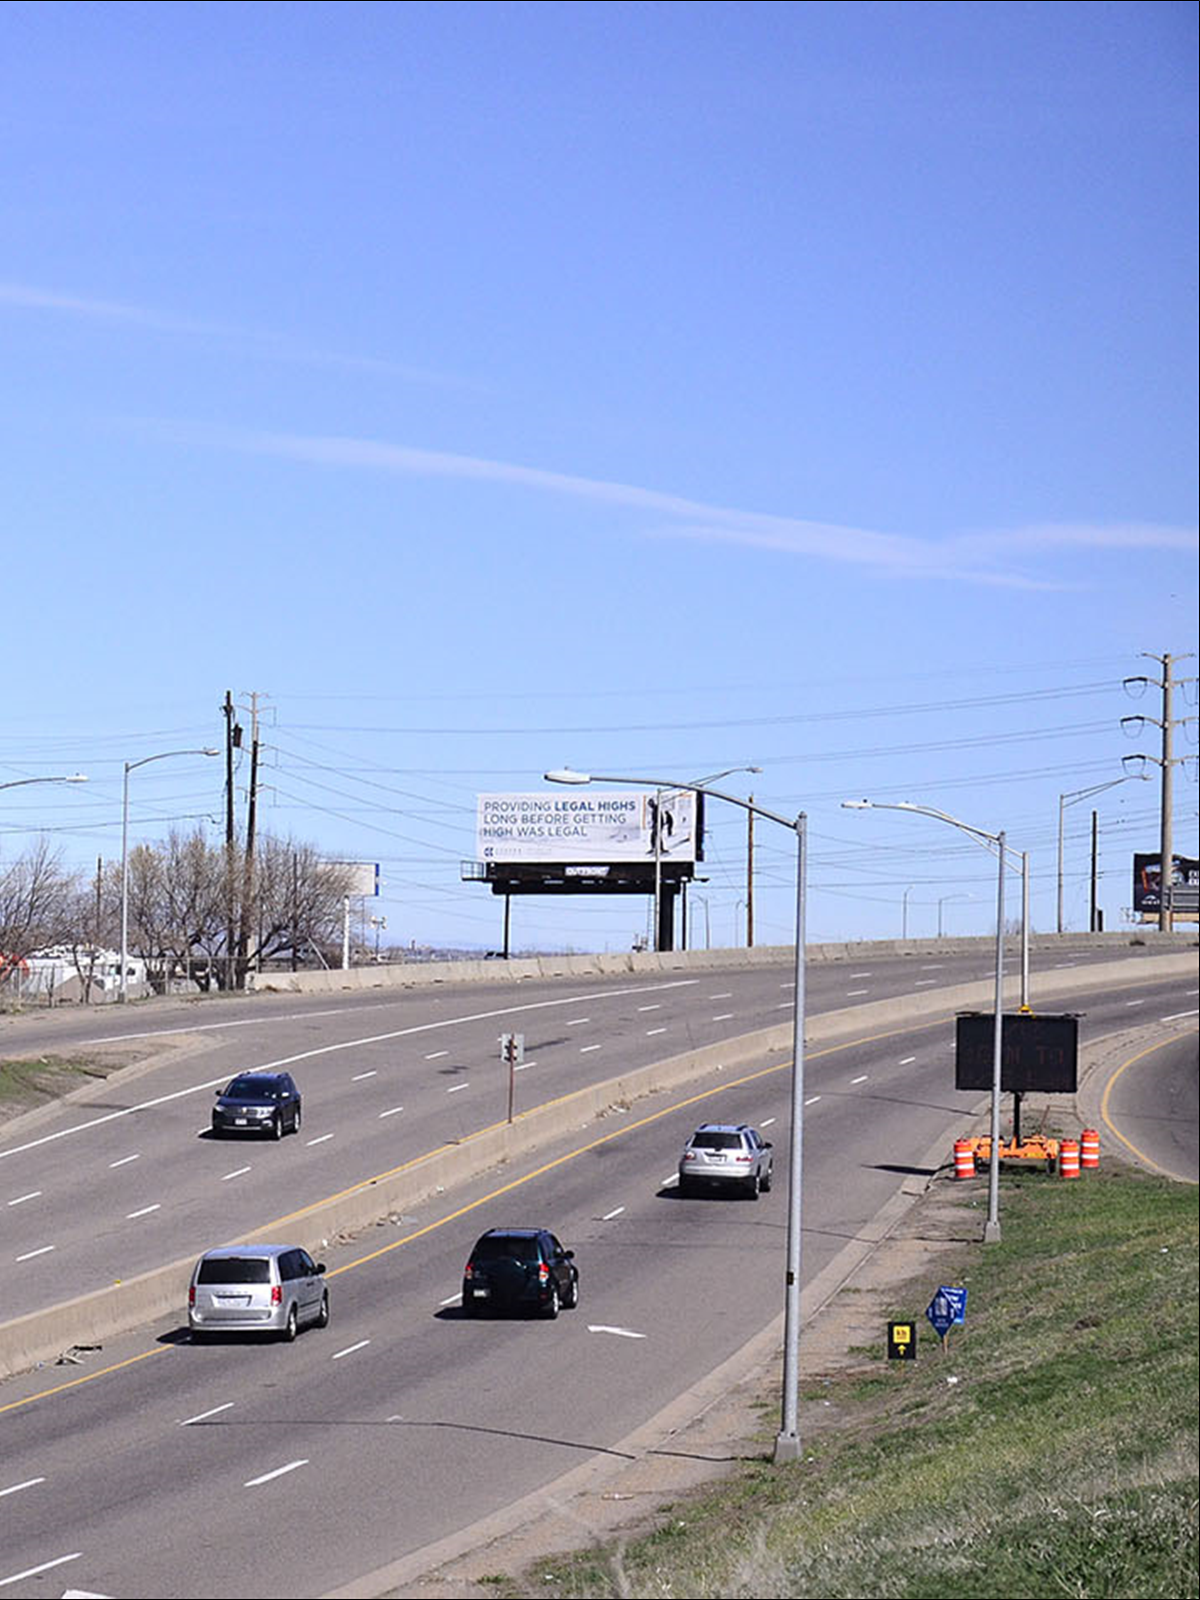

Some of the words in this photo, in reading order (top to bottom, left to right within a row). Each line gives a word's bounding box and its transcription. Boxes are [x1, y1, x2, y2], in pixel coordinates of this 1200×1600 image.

[484, 801, 551, 812] PROVIDING
[554, 801, 594, 811] LEGAL
[598, 801, 636, 811] HIGHS
[484, 813, 517, 824] LONG
[521, 813, 569, 824] BEFORE
[573, 813, 626, 824] GETTING
[483, 826, 513, 837] HIGH
[517, 826, 545, 837] WAS
[548, 826, 587, 837] LEGAL
